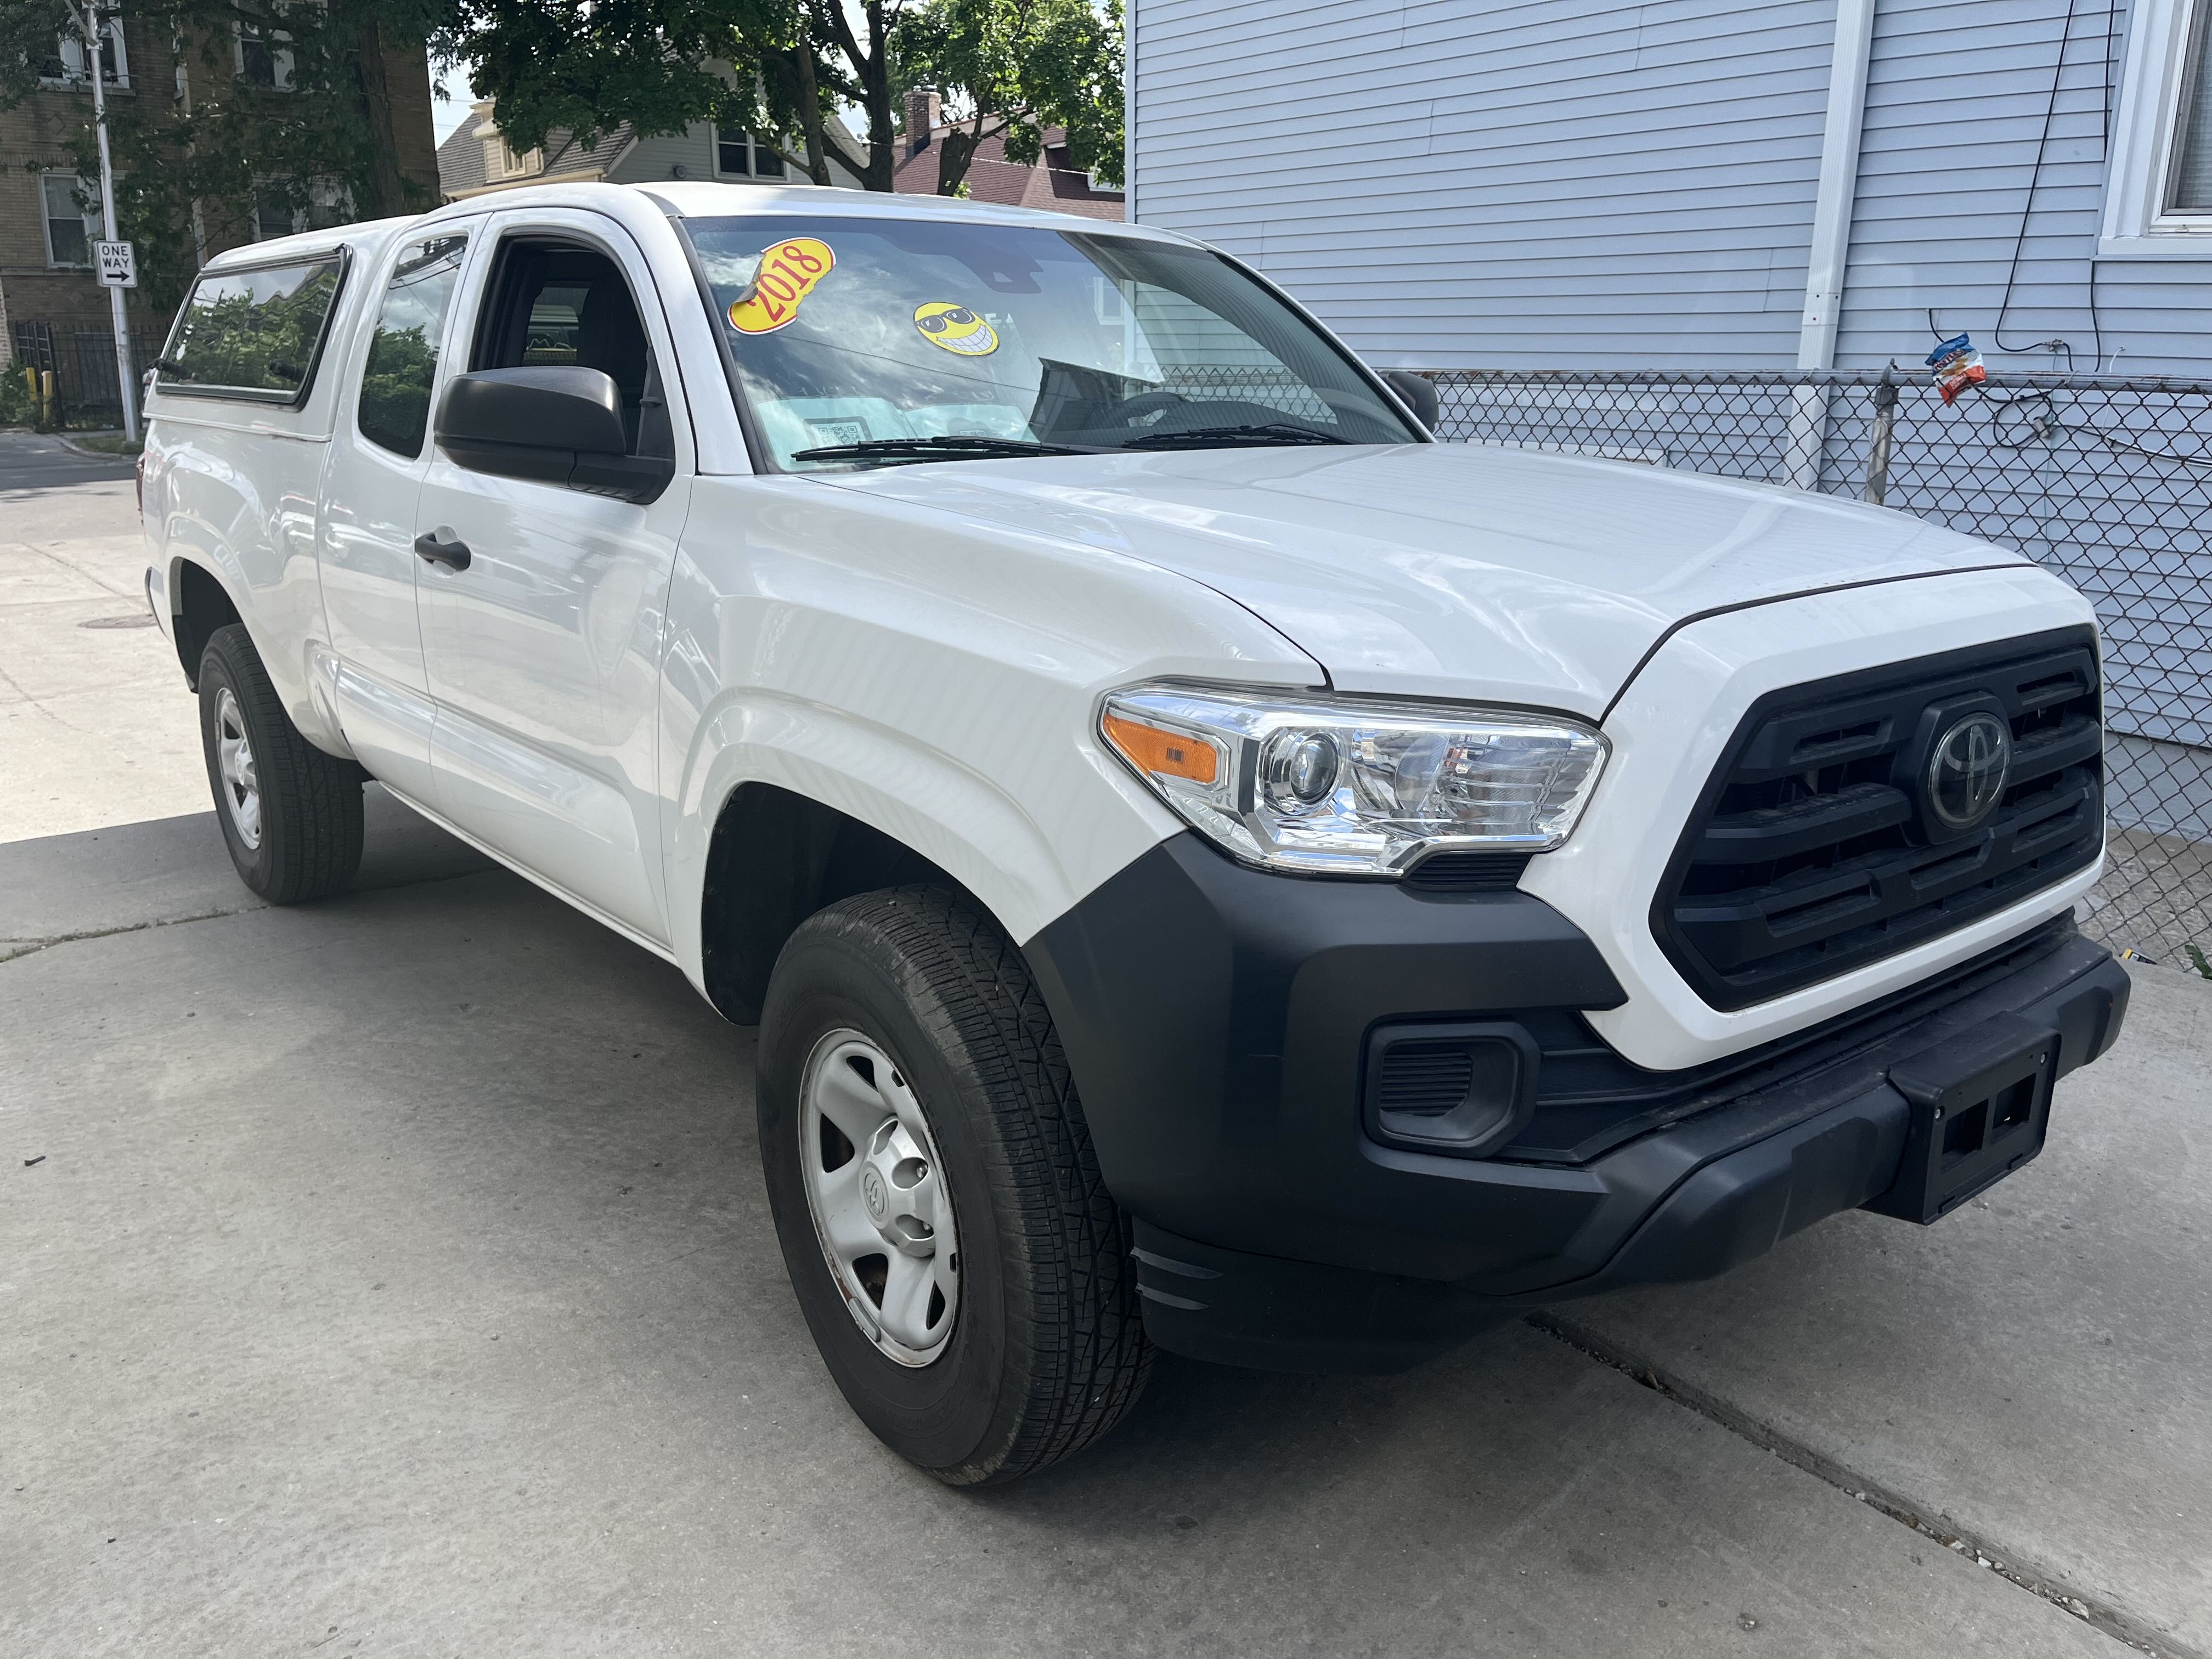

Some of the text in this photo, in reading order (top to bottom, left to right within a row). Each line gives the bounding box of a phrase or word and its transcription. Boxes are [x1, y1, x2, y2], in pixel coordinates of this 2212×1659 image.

[102, 245, 128, 256] ONE
[103, 258, 129, 268] WAY
[747, 245, 822, 323] 2018
